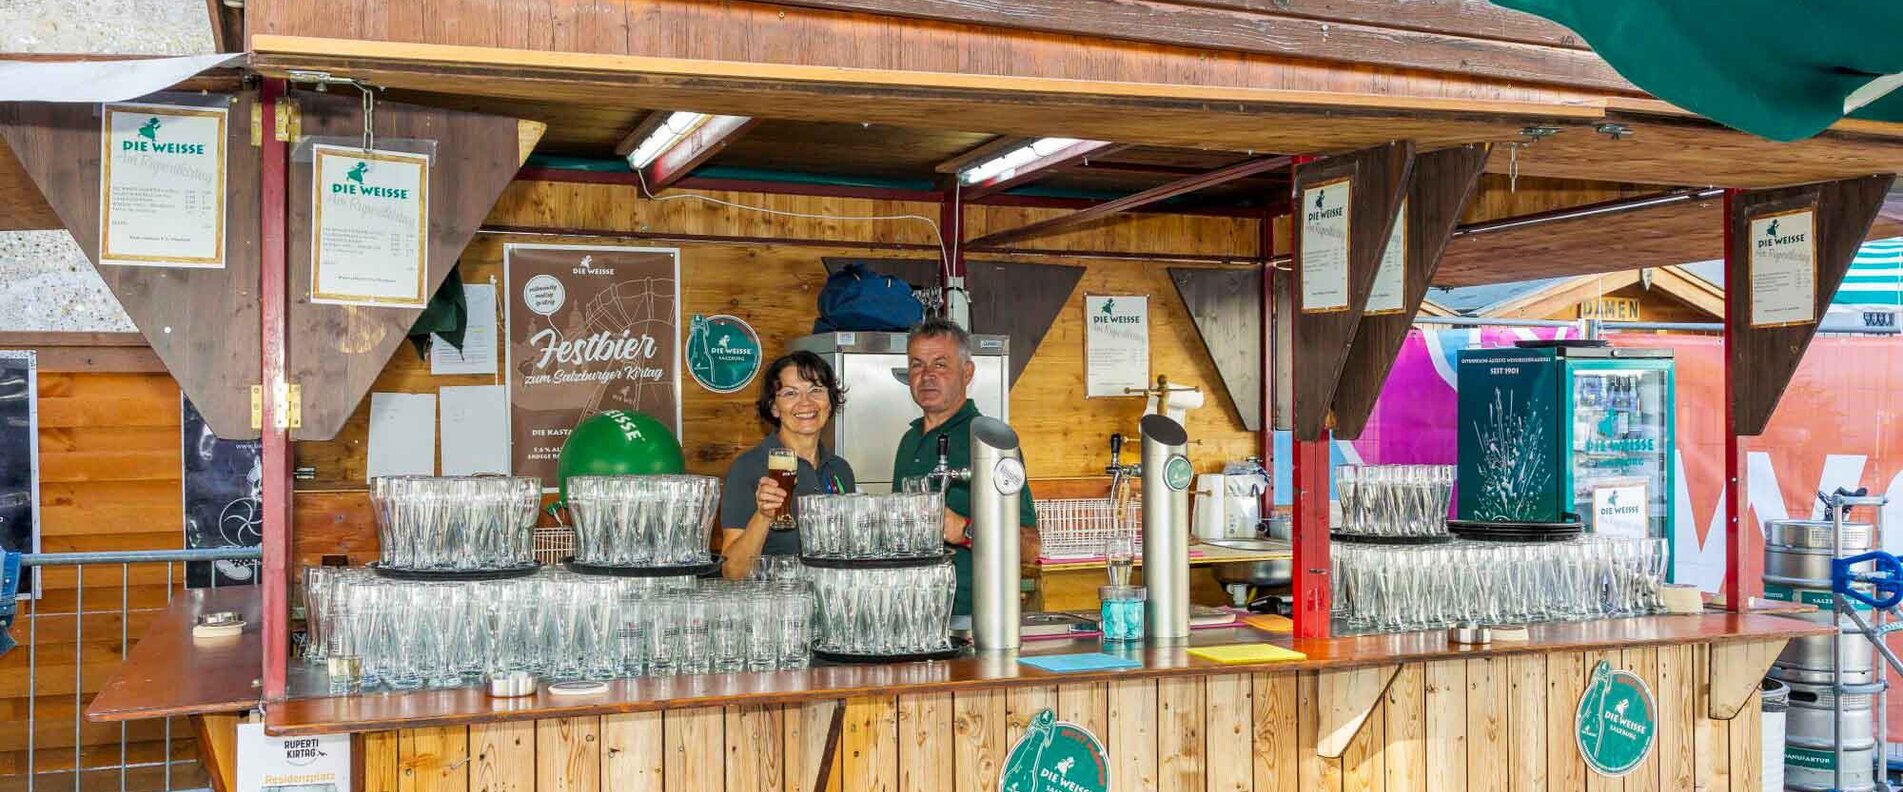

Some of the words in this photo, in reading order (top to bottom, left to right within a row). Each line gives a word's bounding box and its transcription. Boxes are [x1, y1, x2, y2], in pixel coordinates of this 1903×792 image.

[122, 140, 148, 152] DIE
[152, 142, 205, 155] WEISSE
[332, 183, 356, 195] DIE
[360, 185, 408, 199] WEISSE
[1308, 211, 1319, 221] DIE
[1320, 206, 1343, 219] WEISSE
[1758, 239, 1773, 248] DIE
[1774, 233, 1805, 245] WEISSE
[572, 267, 586, 275] DIE
[587, 268, 615, 276] WEISSE
[1582, 299, 1640, 318] DAMEN
[1093, 315, 1108, 324] DIE
[1110, 315, 1141, 324] WEISSE
[530, 328, 657, 369] Festbier
[711, 347, 724, 355] DIE
[525, 374, 551, 385] zum
[551, 369, 622, 386] Salzburger
[623, 365, 664, 382] Kirtag
[1490, 367, 1503, 375] SEIT
[1609, 438, 1655, 452] WEISSE
[1600, 507, 1613, 515] DIE
[1614, 505, 1639, 514] WEISSE
[1604, 710, 1619, 724] DIE
[1619, 715, 1647, 736] WEISSE
[1609, 724, 1637, 740] SALZBURG
[284, 738, 319, 749] RUPERTI
[286, 748, 316, 759] KIRTAG
[265, 772, 336, 784] Residenzplatz
[1040, 768, 1059, 783] DIE
